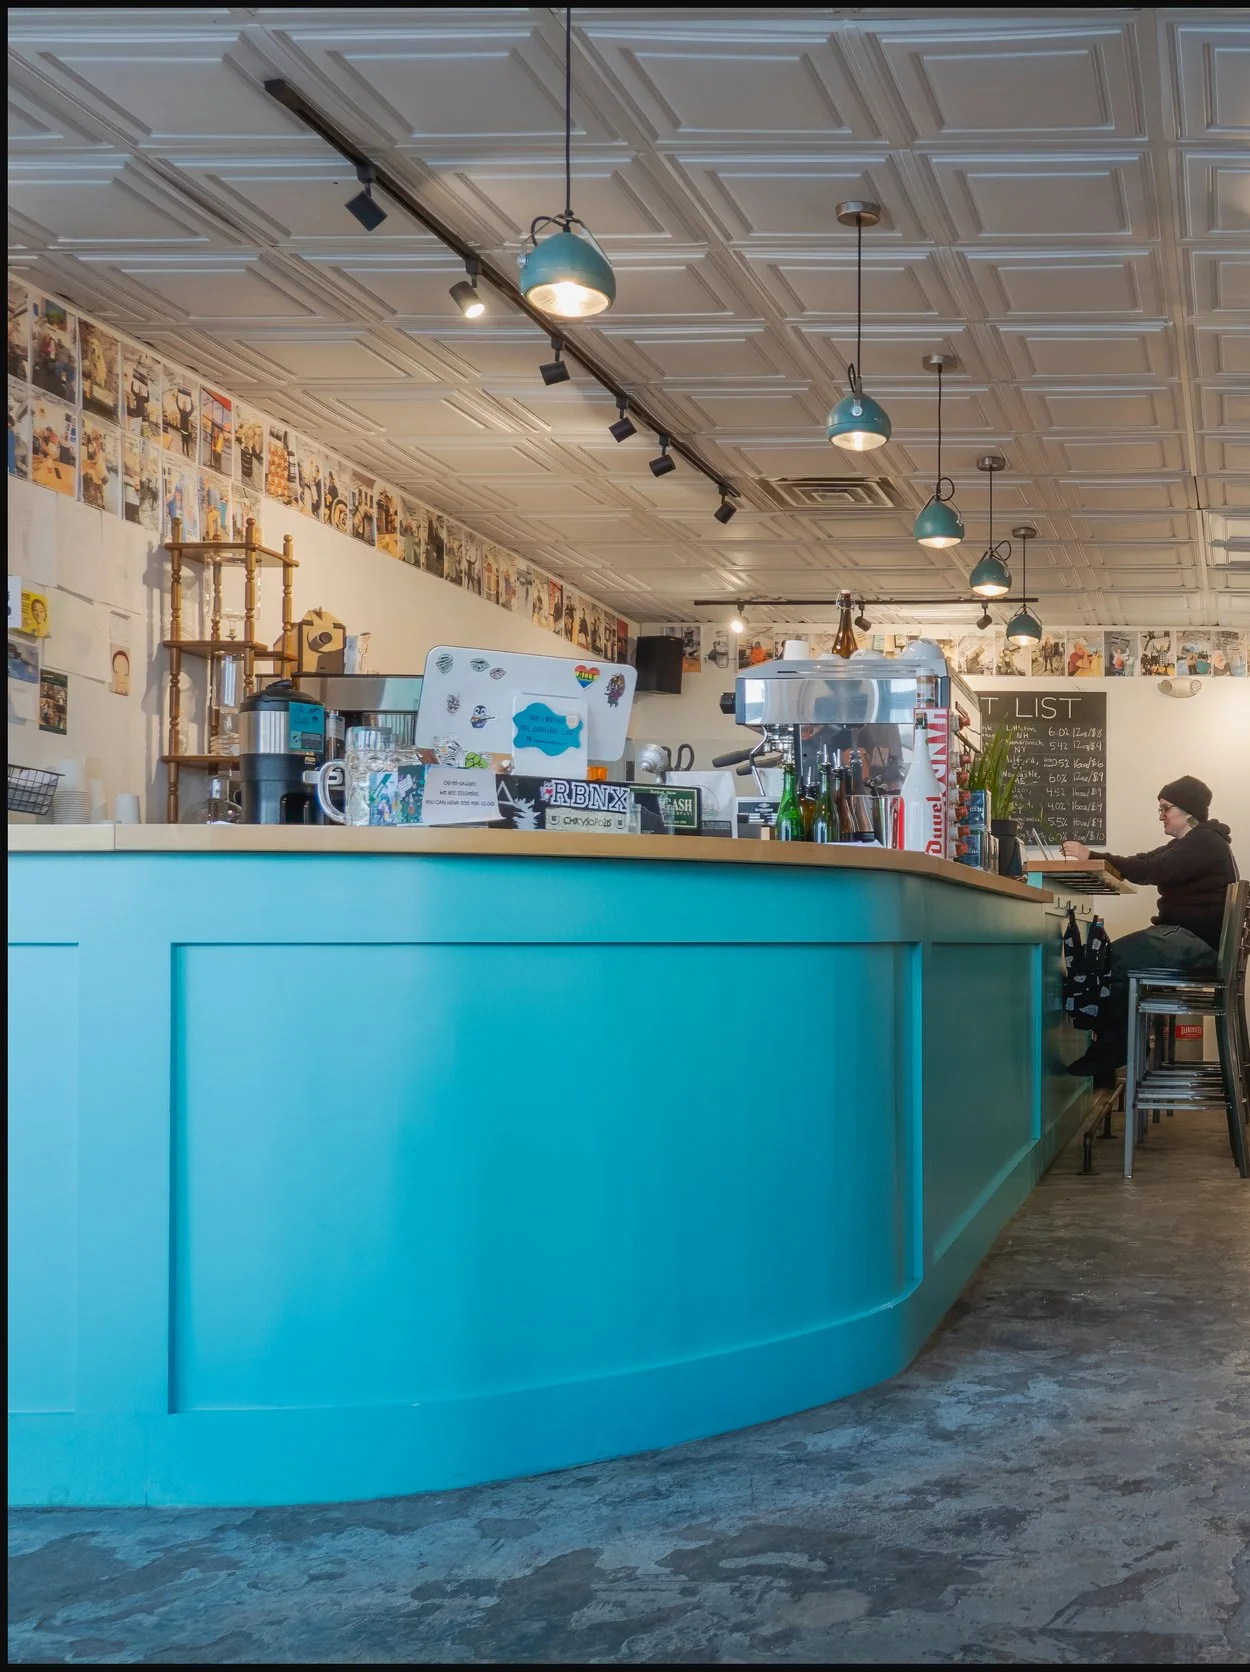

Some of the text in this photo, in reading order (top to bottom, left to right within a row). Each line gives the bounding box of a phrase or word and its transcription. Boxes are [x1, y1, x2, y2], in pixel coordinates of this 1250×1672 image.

[1015, 696, 1082, 719] LIST
[550, 779, 630, 812] RBNX
[925, 796, 943, 855] Duvel
